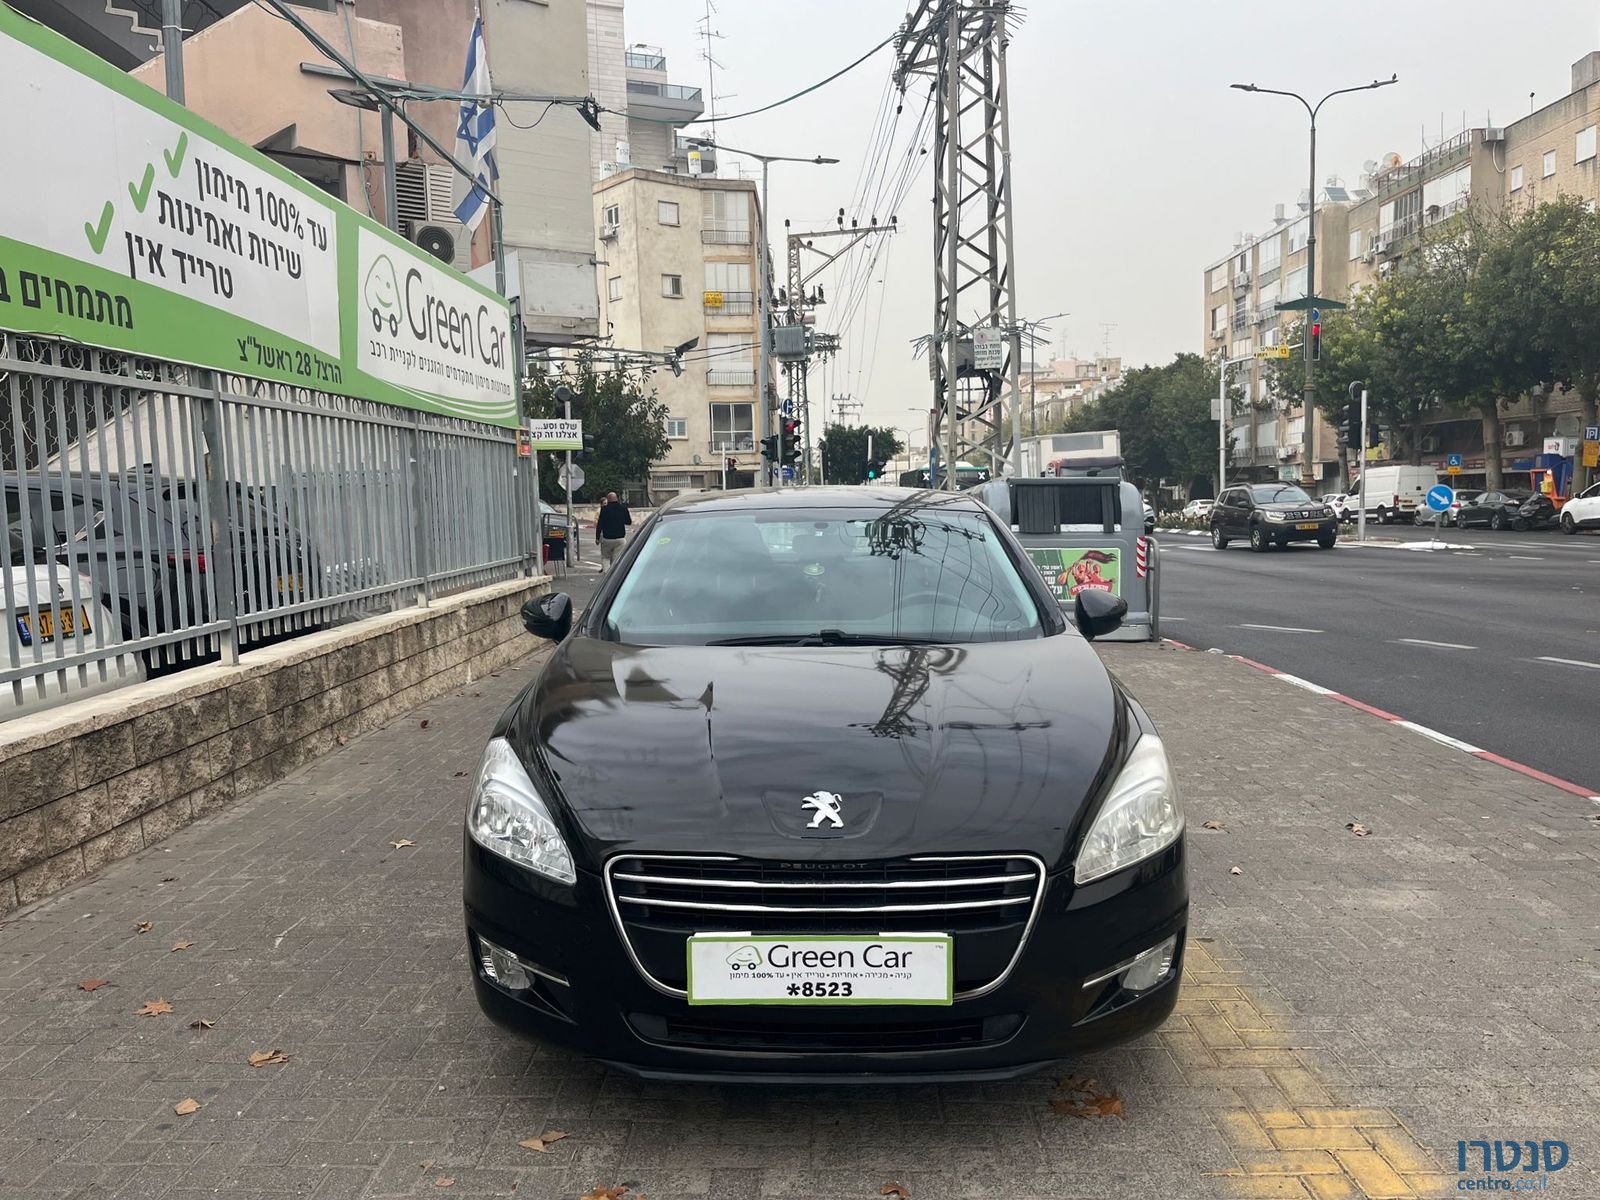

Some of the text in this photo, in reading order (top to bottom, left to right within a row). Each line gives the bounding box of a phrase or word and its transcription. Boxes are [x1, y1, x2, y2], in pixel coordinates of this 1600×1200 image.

[195, 158, 327, 251] עד 100% מימון
[157, 190, 301, 280] שירות ואמינות
[125, 231, 233, 299] טרייד אין
[19, 270, 134, 329] מתמחים
[405, 268, 506, 370] Green Car
[370, 340, 387, 359] רכב
[389, 346, 416, 371] לקניית
[236, 335, 342, 384] הרצל 28 ראשל"צ
[419, 356, 444, 376] והוגנים
[446, 364, 474, 386] מתקדמים
[474, 374, 490, 390] מימון
[555, 430, 578, 439] אצלנו
[559, 421, 578, 430] שלם
[767, 944, 913, 968] Green Car
[729, 972, 750, 980] מימון
[791, 972, 803, 981] אין
[804, 971, 825, 979] טרייד
[831, 971, 858, 979] אחריות
[864, 971, 888, 979] מכירה
[894, 972, 912, 981] קניה
